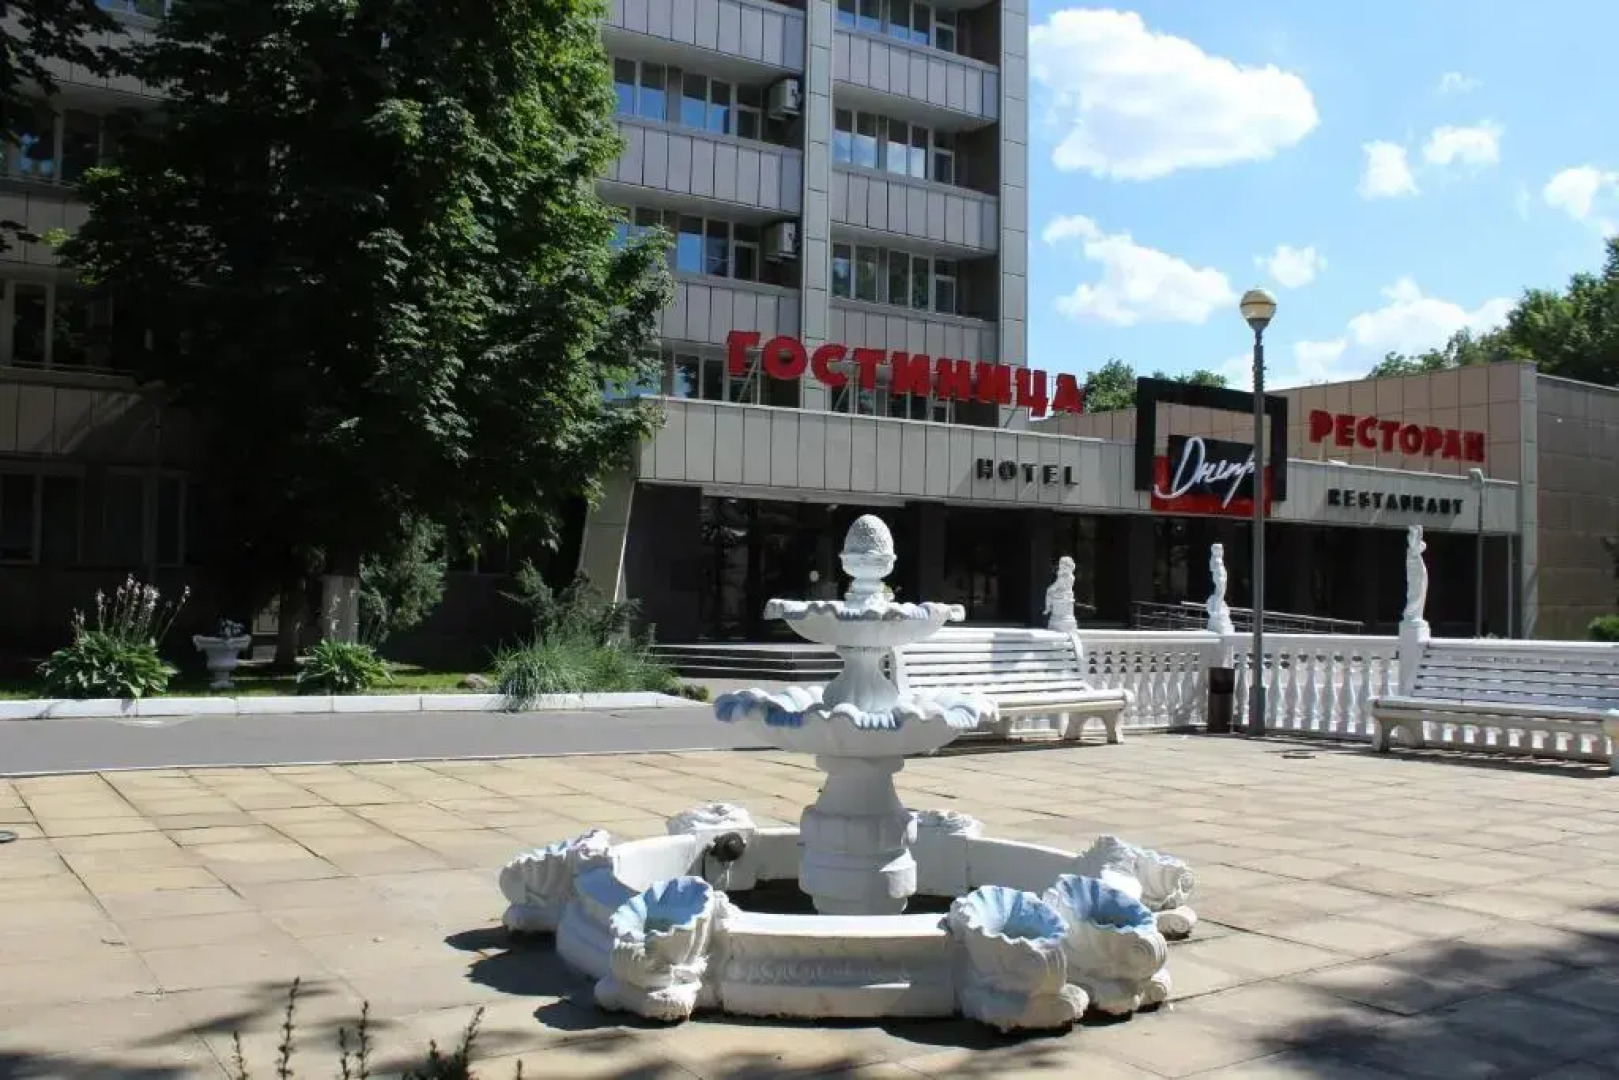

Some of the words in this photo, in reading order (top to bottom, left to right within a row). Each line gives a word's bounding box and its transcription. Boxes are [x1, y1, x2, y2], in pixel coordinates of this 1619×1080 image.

[726, 330, 1084, 417] ГОСТИНИЦА
[1309, 410, 1484, 462] РЕСТОРАН
[977, 458, 1078, 486] HOTEL
[1327, 488, 1463, 514] RESTAURANT
